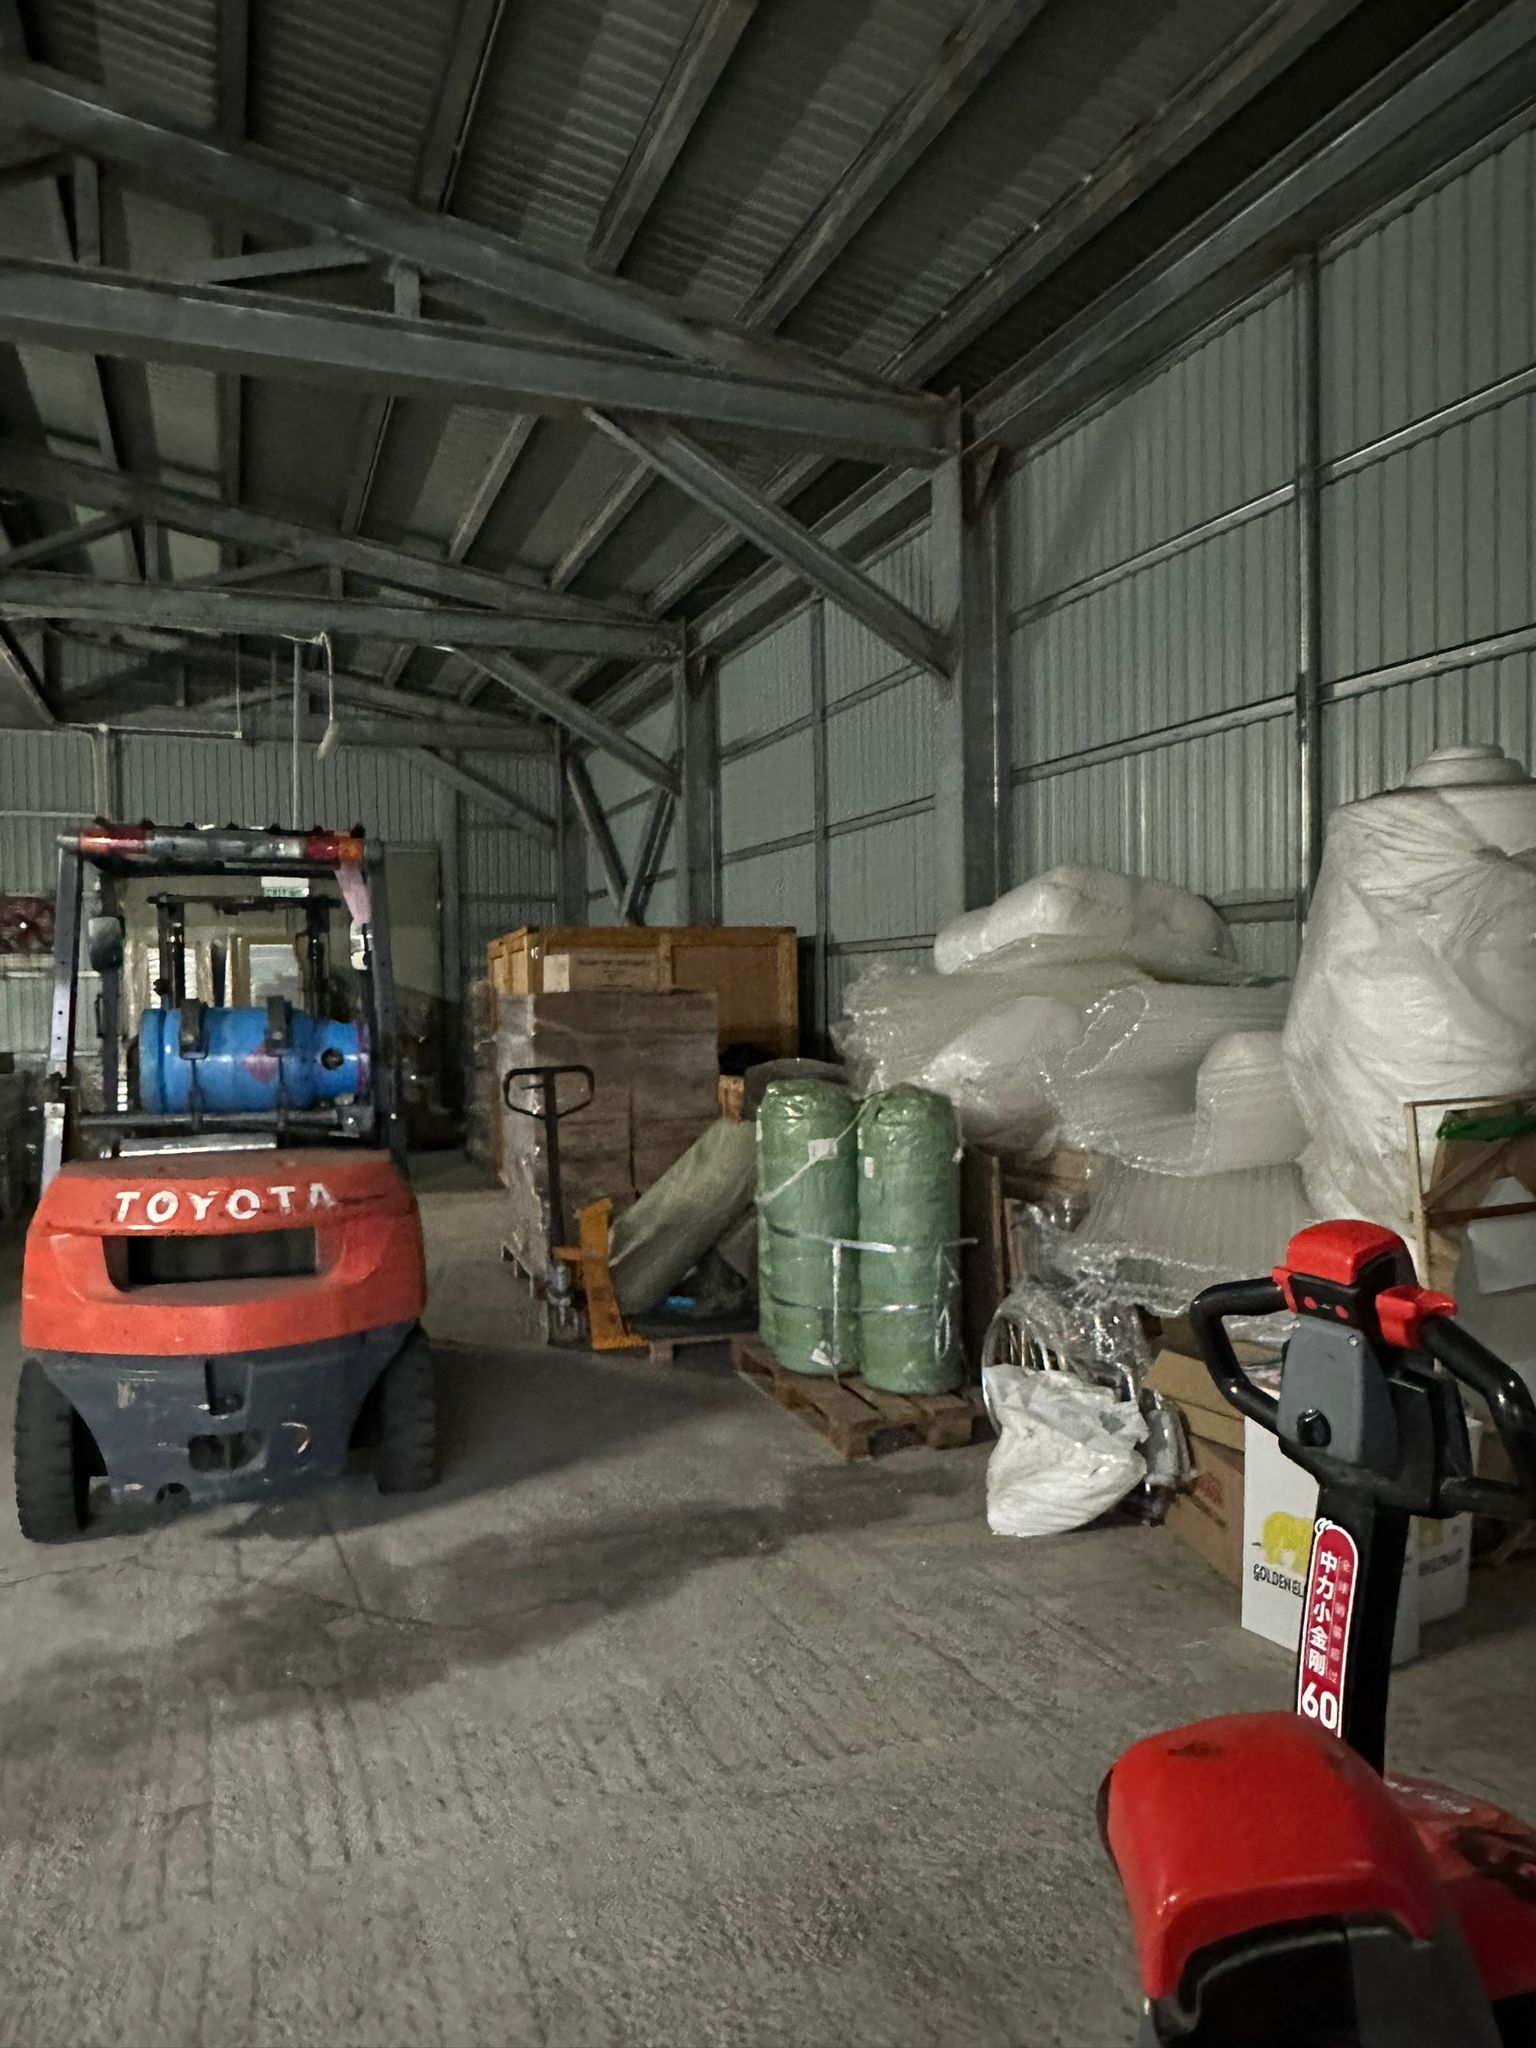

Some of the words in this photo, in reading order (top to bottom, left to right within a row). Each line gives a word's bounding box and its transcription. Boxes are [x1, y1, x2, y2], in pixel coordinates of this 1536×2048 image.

[115, 1182, 336, 1224] TOYOTA
[1253, 1563, 1291, 1591] GOLDEN
[1308, 1550, 1337, 1677] 中力小金刚
[1302, 1682, 1338, 1730] 60
